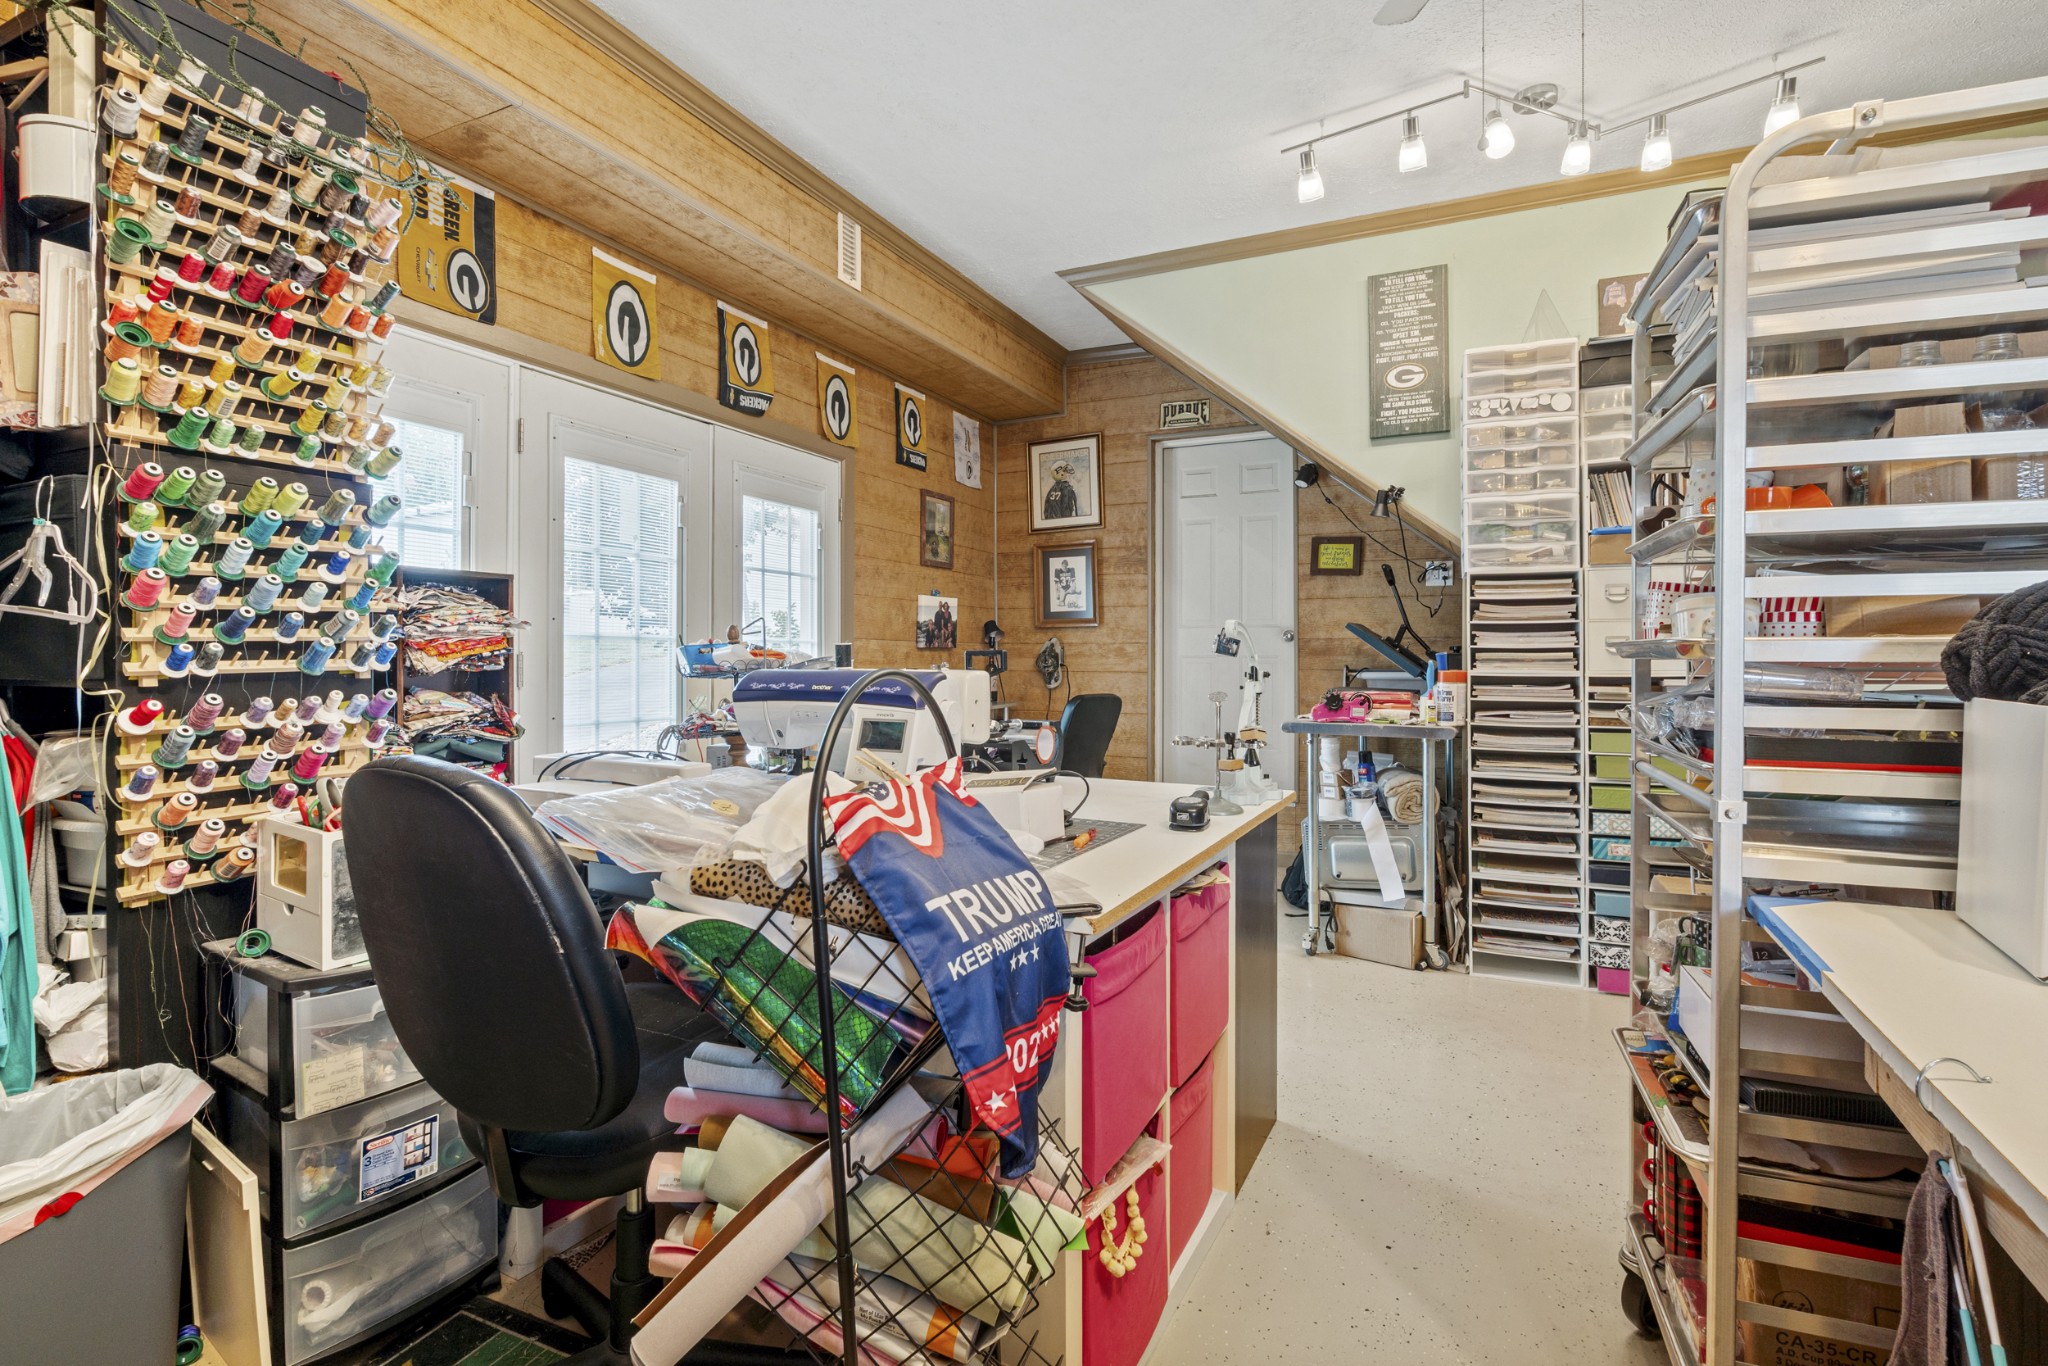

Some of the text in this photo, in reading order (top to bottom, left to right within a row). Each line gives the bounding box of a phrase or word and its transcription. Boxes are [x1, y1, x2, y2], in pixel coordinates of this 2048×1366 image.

[448, 249, 488, 312] G
[607, 282, 649, 365] G
[732, 324, 761, 385] G
[1385, 363, 1426, 389] G
[825, 376, 850, 438] G
[903, 399, 922, 446] G
[1163, 401, 1207, 428] PURDUE
[1049, 491, 1061, 500] 37
[925, 870, 1045, 943] TRUMP
[947, 942, 993, 982] KEEP
[991, 920, 1042, 956] AMERICA
[1755, 951, 1769, 960] 12
[364, 1156, 372, 1167] 3
[1775, 1331, 1877, 1366] CA-35-CR
[1802, 1352, 1825, 1365] Cup
